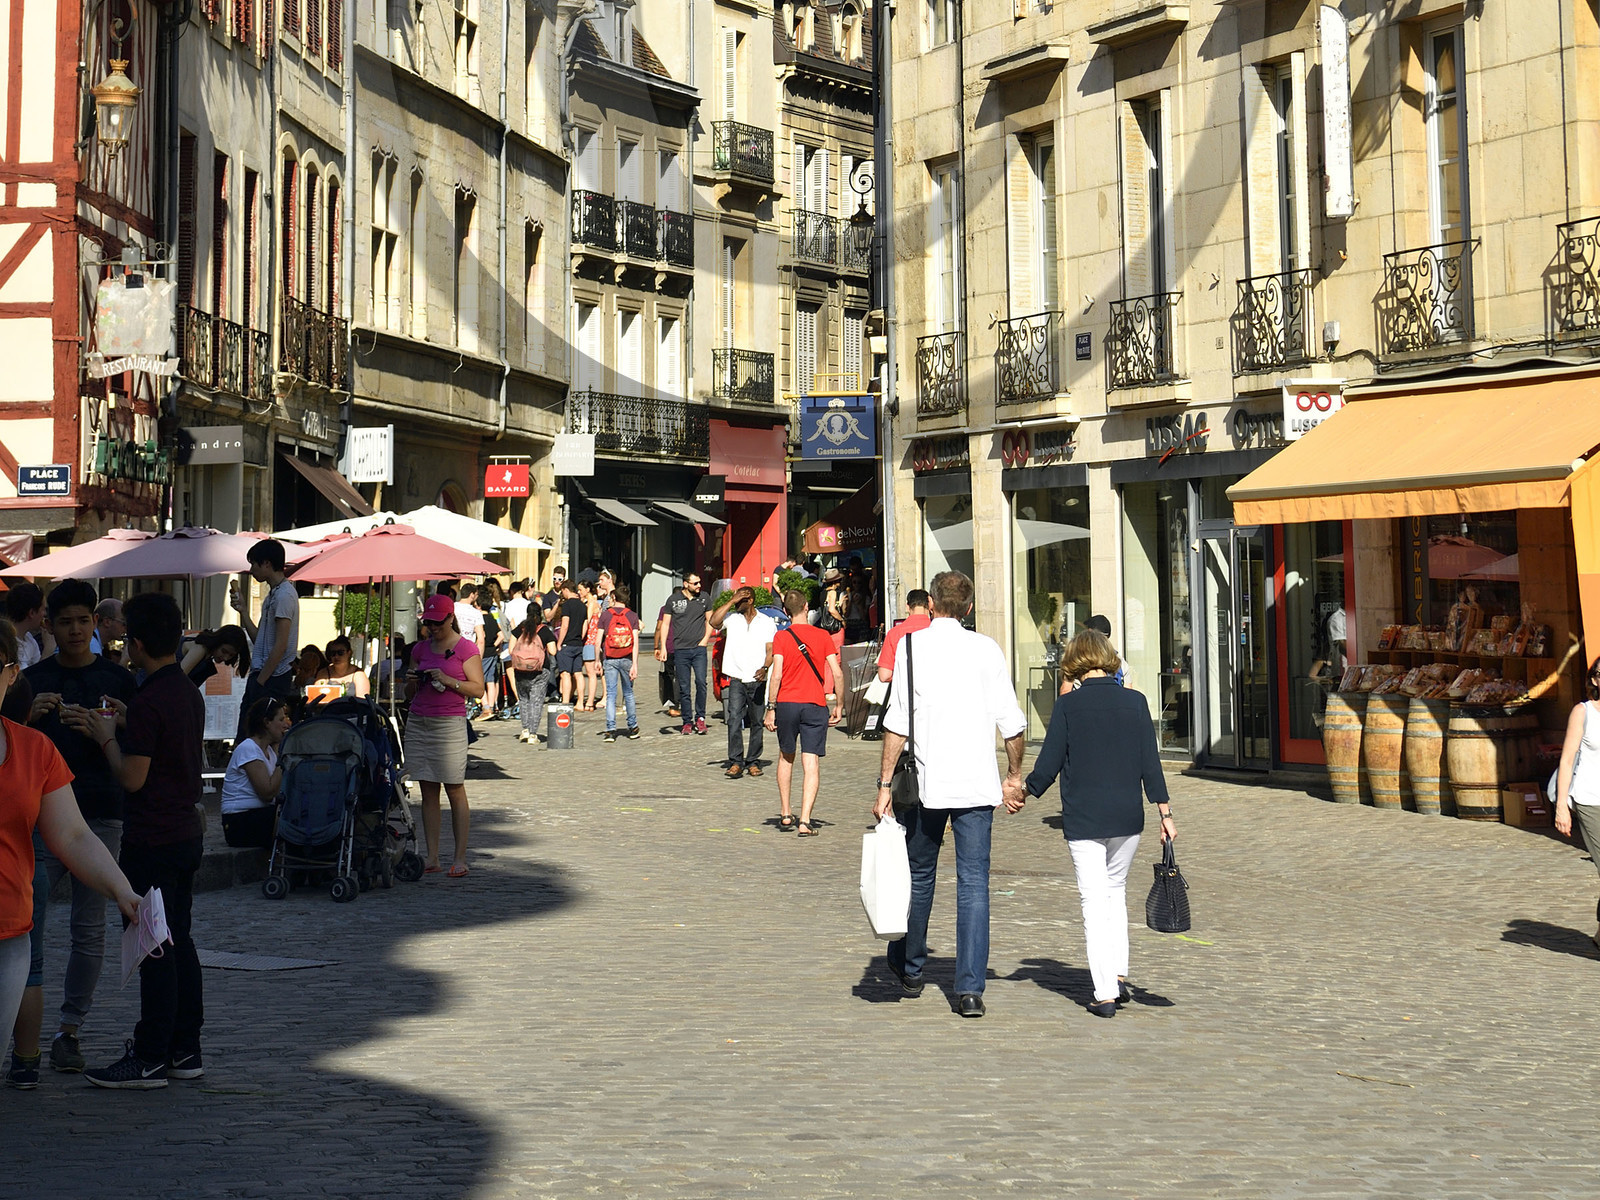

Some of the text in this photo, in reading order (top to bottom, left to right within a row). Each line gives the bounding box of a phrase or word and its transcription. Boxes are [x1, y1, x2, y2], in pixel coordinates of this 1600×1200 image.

[1078, 336, 1089, 344] PLACE
[102, 356, 168, 376] RESTAURANT
[1146, 411, 1208, 451] LISSAC
[179, 439, 241, 449] sandro
[816, 446, 861, 456] Gastronomie
[30, 469, 59, 479] PLACE
[47, 481, 67, 491] RUDE
